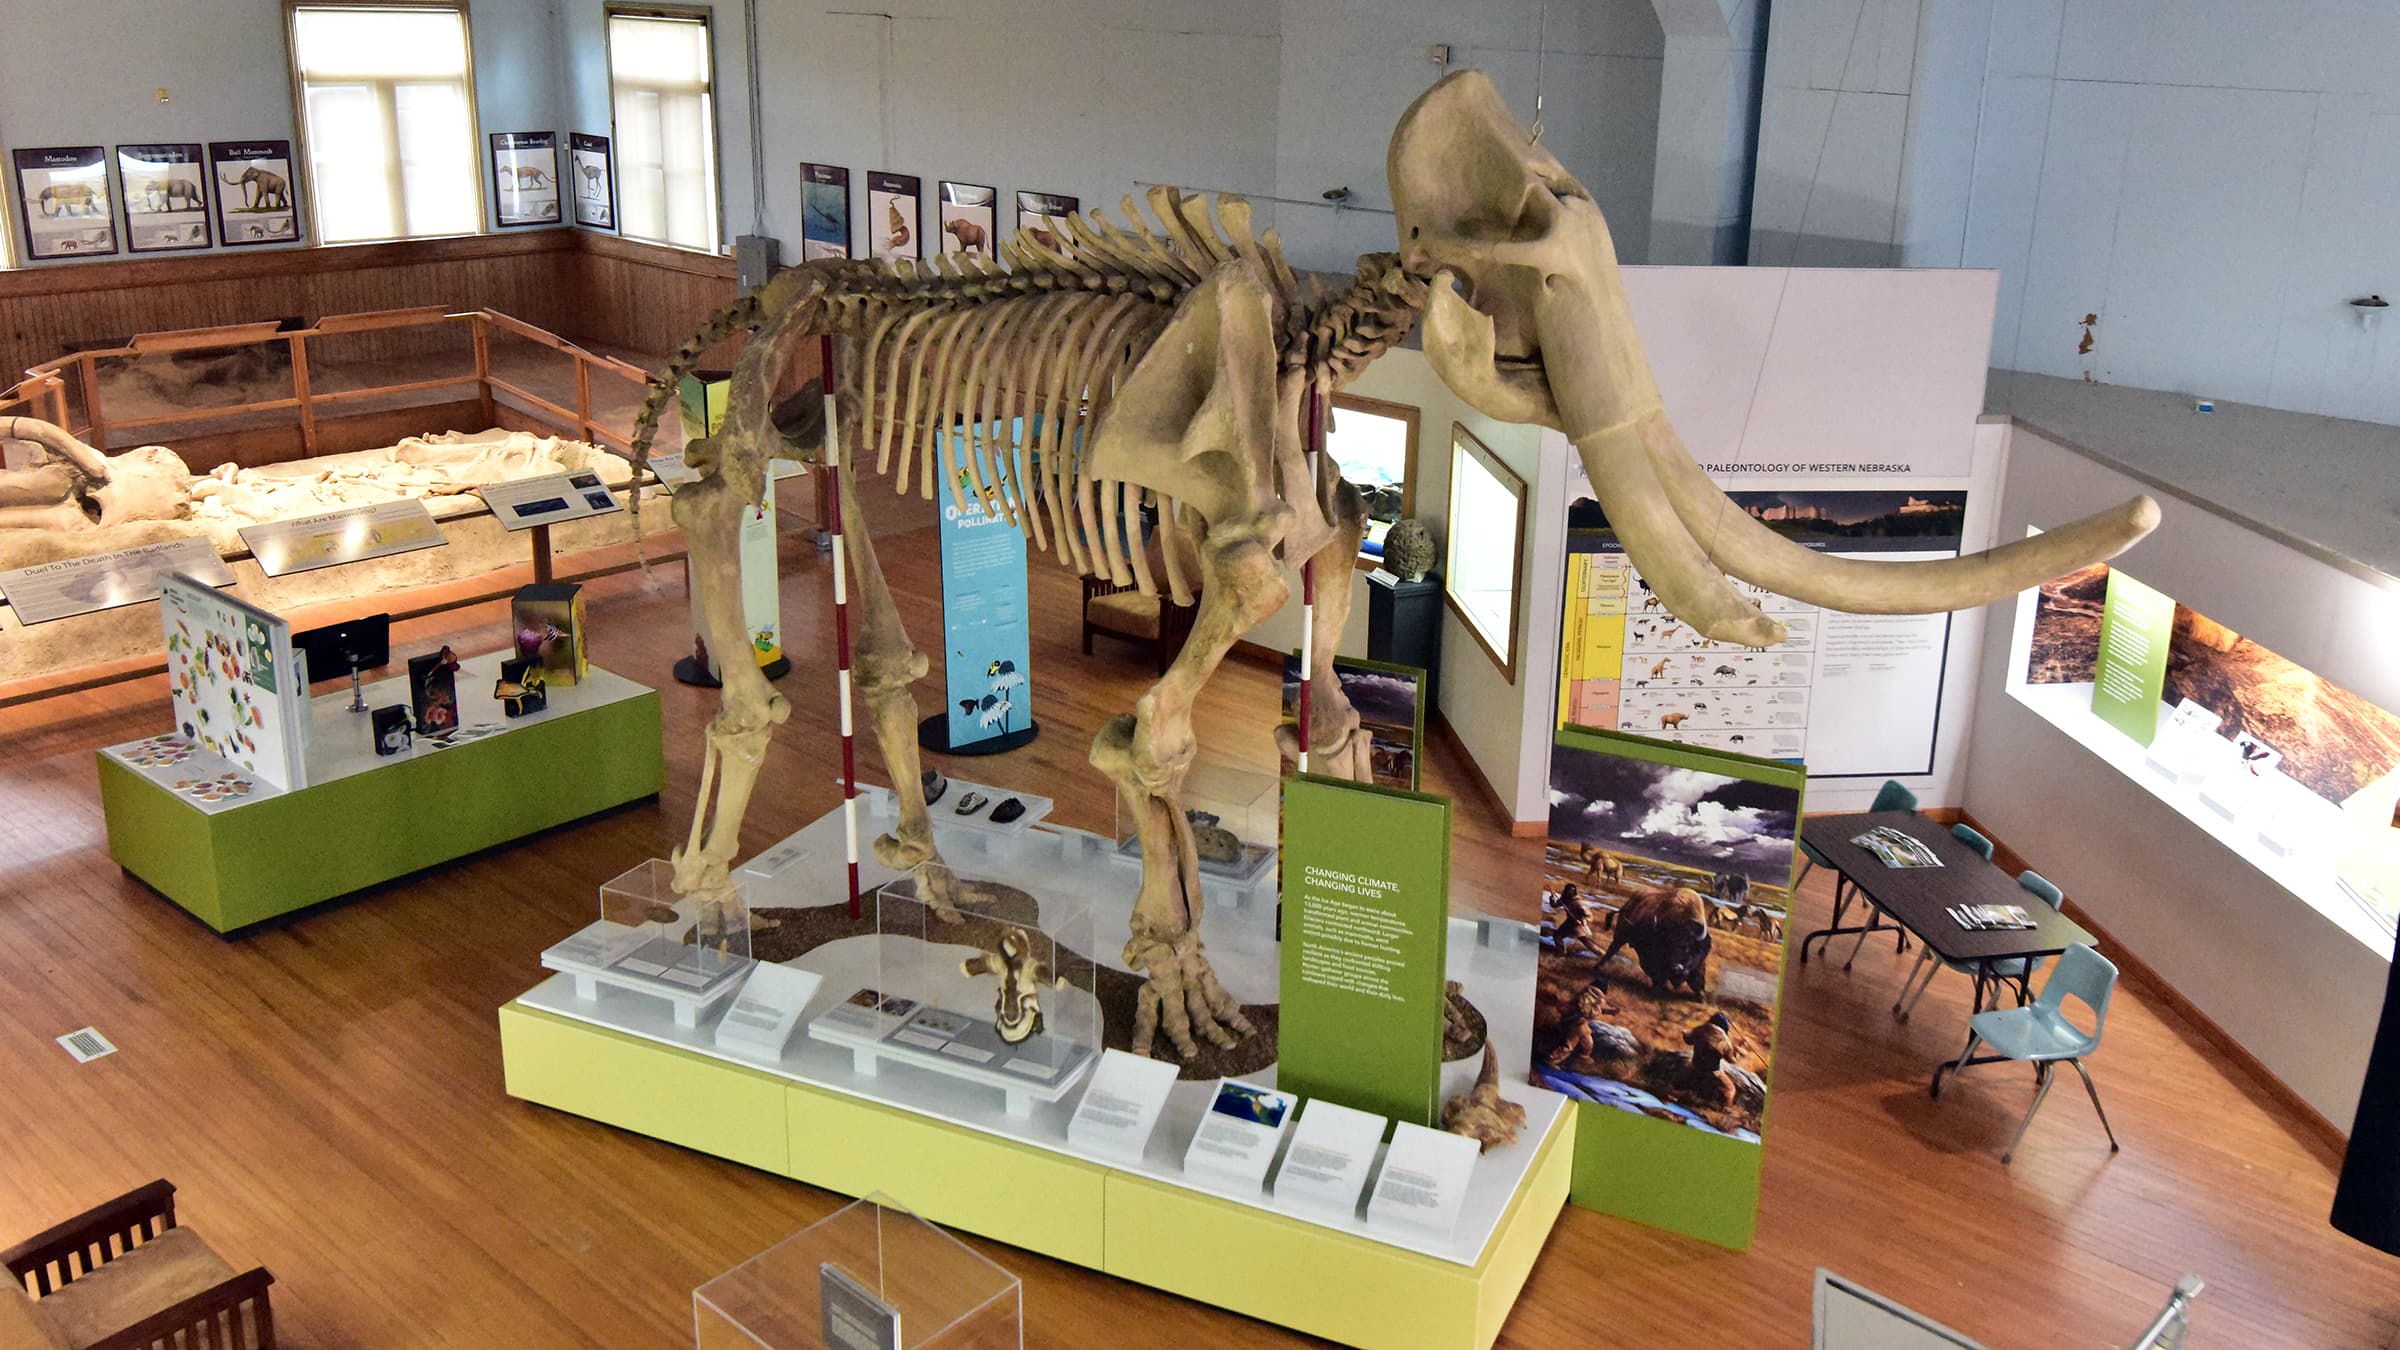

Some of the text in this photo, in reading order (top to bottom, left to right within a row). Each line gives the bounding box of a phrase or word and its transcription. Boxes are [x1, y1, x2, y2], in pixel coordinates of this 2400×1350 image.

[1706, 464, 1790, 472] PALEONTOLOGY
[1792, 464, 1806, 472] OF
[1809, 464, 1856, 472] WESTERN
[1858, 464, 1911, 472] NEBRASKA
[24, 566, 48, 576] Duel
[63, 560, 80, 569] The
[82, 555, 112, 566] Death
[113, 552, 123, 560] In
[124, 550, 141, 559] The
[142, 542, 185, 554] Badlands
[1304, 876, 1382, 899] CHANGING LIVES
[1305, 865, 1400, 893] CHANGING CLIMATE,
